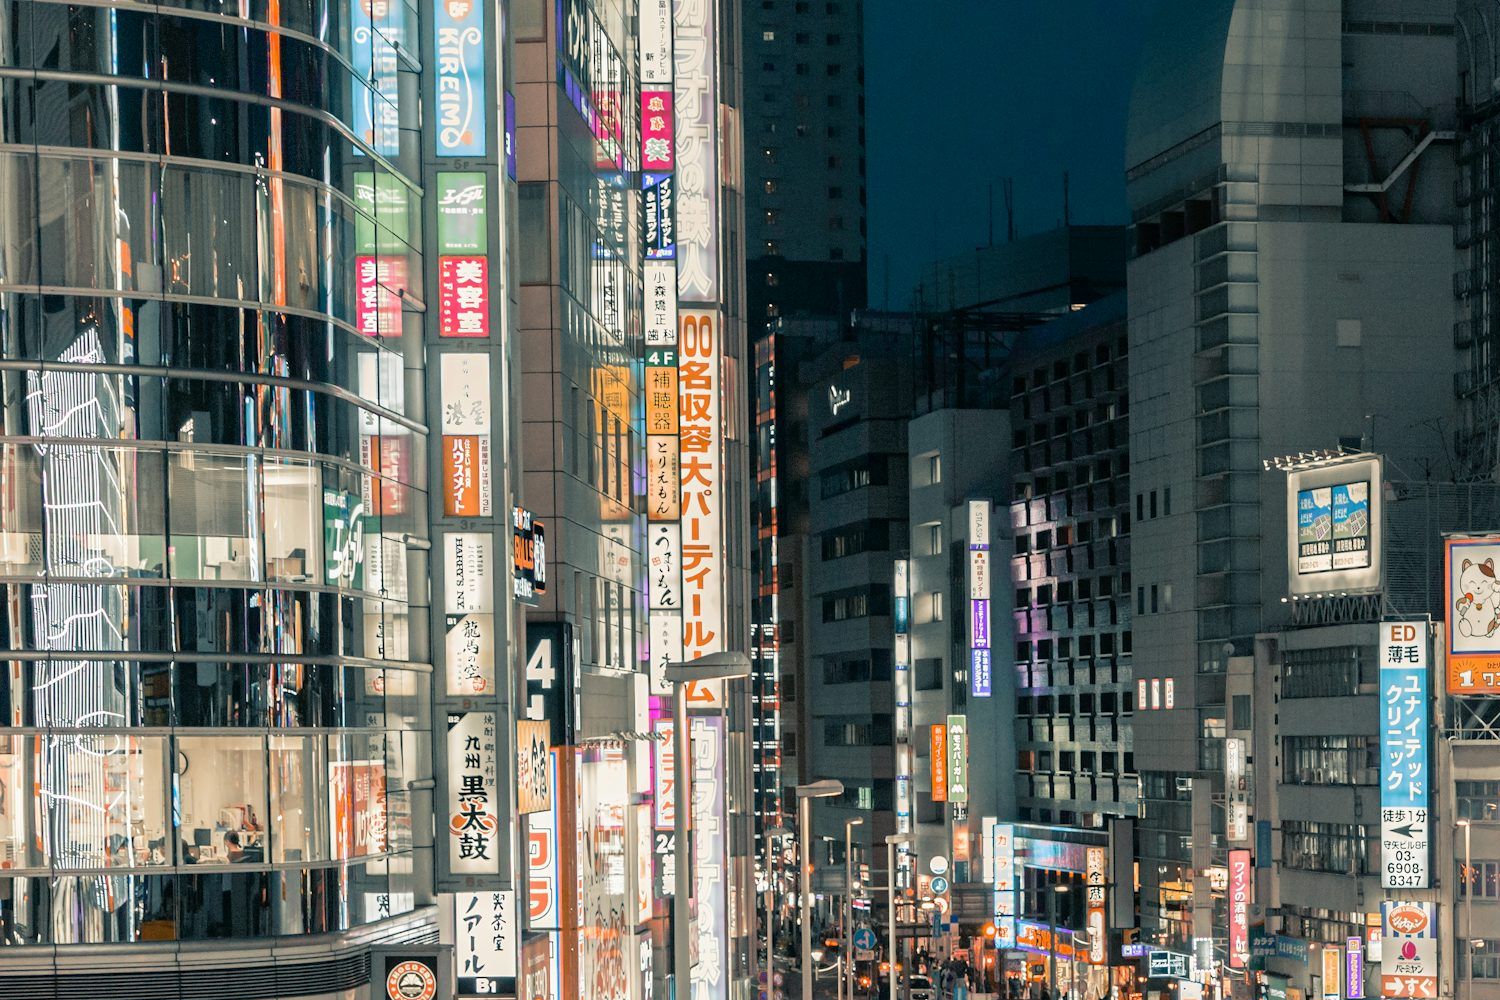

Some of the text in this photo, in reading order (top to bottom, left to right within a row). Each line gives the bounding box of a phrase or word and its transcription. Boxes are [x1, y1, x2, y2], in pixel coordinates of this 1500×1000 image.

[645, 52, 655, 80] 新宿
[438, 27, 461, 148] KIREIMO
[660, 177, 673, 248] インターネット
[455, 260, 484, 333] 美容室
[647, 329, 675, 342] 歯科
[648, 352, 674, 365] 4F
[652, 371, 672, 430] 補聴器
[452, 438, 465, 514] ハウスメイト
[656, 441, 670, 515] とりえもん
[455, 537, 464, 587] HARRY'S
[476, 544, 484, 577] SUNTORY
[654, 526, 676, 606] うまいもん
[462, 619, 482, 680] 龍馬の空
[1390, 625, 1416, 642] ED
[1388, 645, 1419, 664] 薄毛
[1386, 684, 1404, 791] クリニック
[1404, 675, 1422, 801] ユナイテッド
[952, 735, 962, 782] モスバーガー
[1383, 809, 1426, 823] 徒歩1分
[1383, 840, 1427, 850] 守矢ビル8F
[1395, 850, 1416, 862] 03-
[1387, 862, 1424, 874] 6908-
[1388, 874, 1422, 887] 8347
[1234, 861, 1246, 930] ワインの酒場。
[490, 893, 507, 952] 喫茶室
[475, 978, 497, 994] B1
[1394, 964, 1425, 974] バーミヤン
[1404, 977, 1433, 996] すぐ
